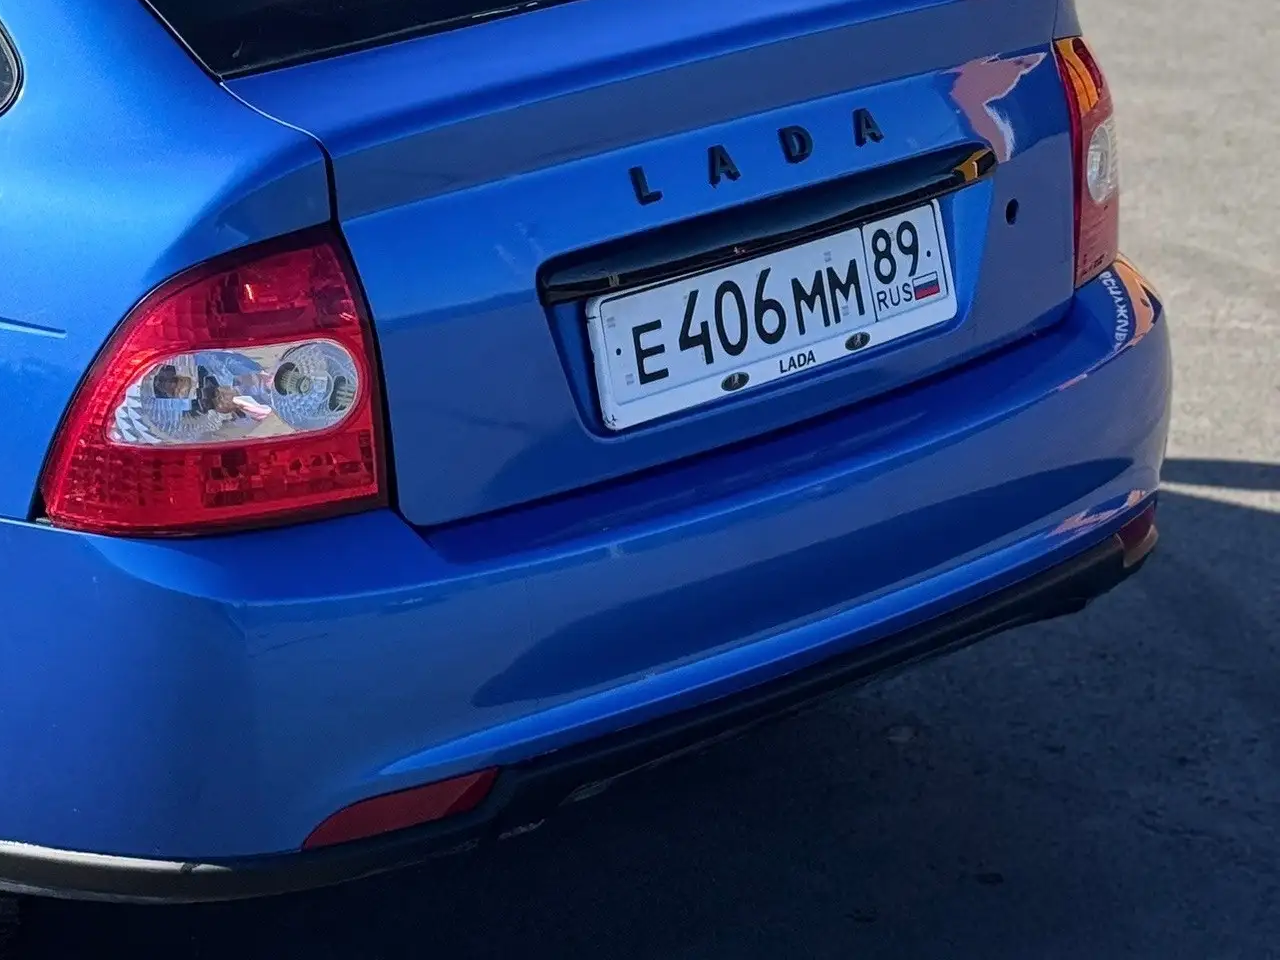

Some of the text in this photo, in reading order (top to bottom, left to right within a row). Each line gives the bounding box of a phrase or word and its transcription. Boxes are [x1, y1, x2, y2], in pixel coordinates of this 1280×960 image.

[628, 107, 885, 206] LADA
[871, 220, 919, 285] 89
[876, 282, 913, 312] RUS
[779, 349, 817, 374] LADA
